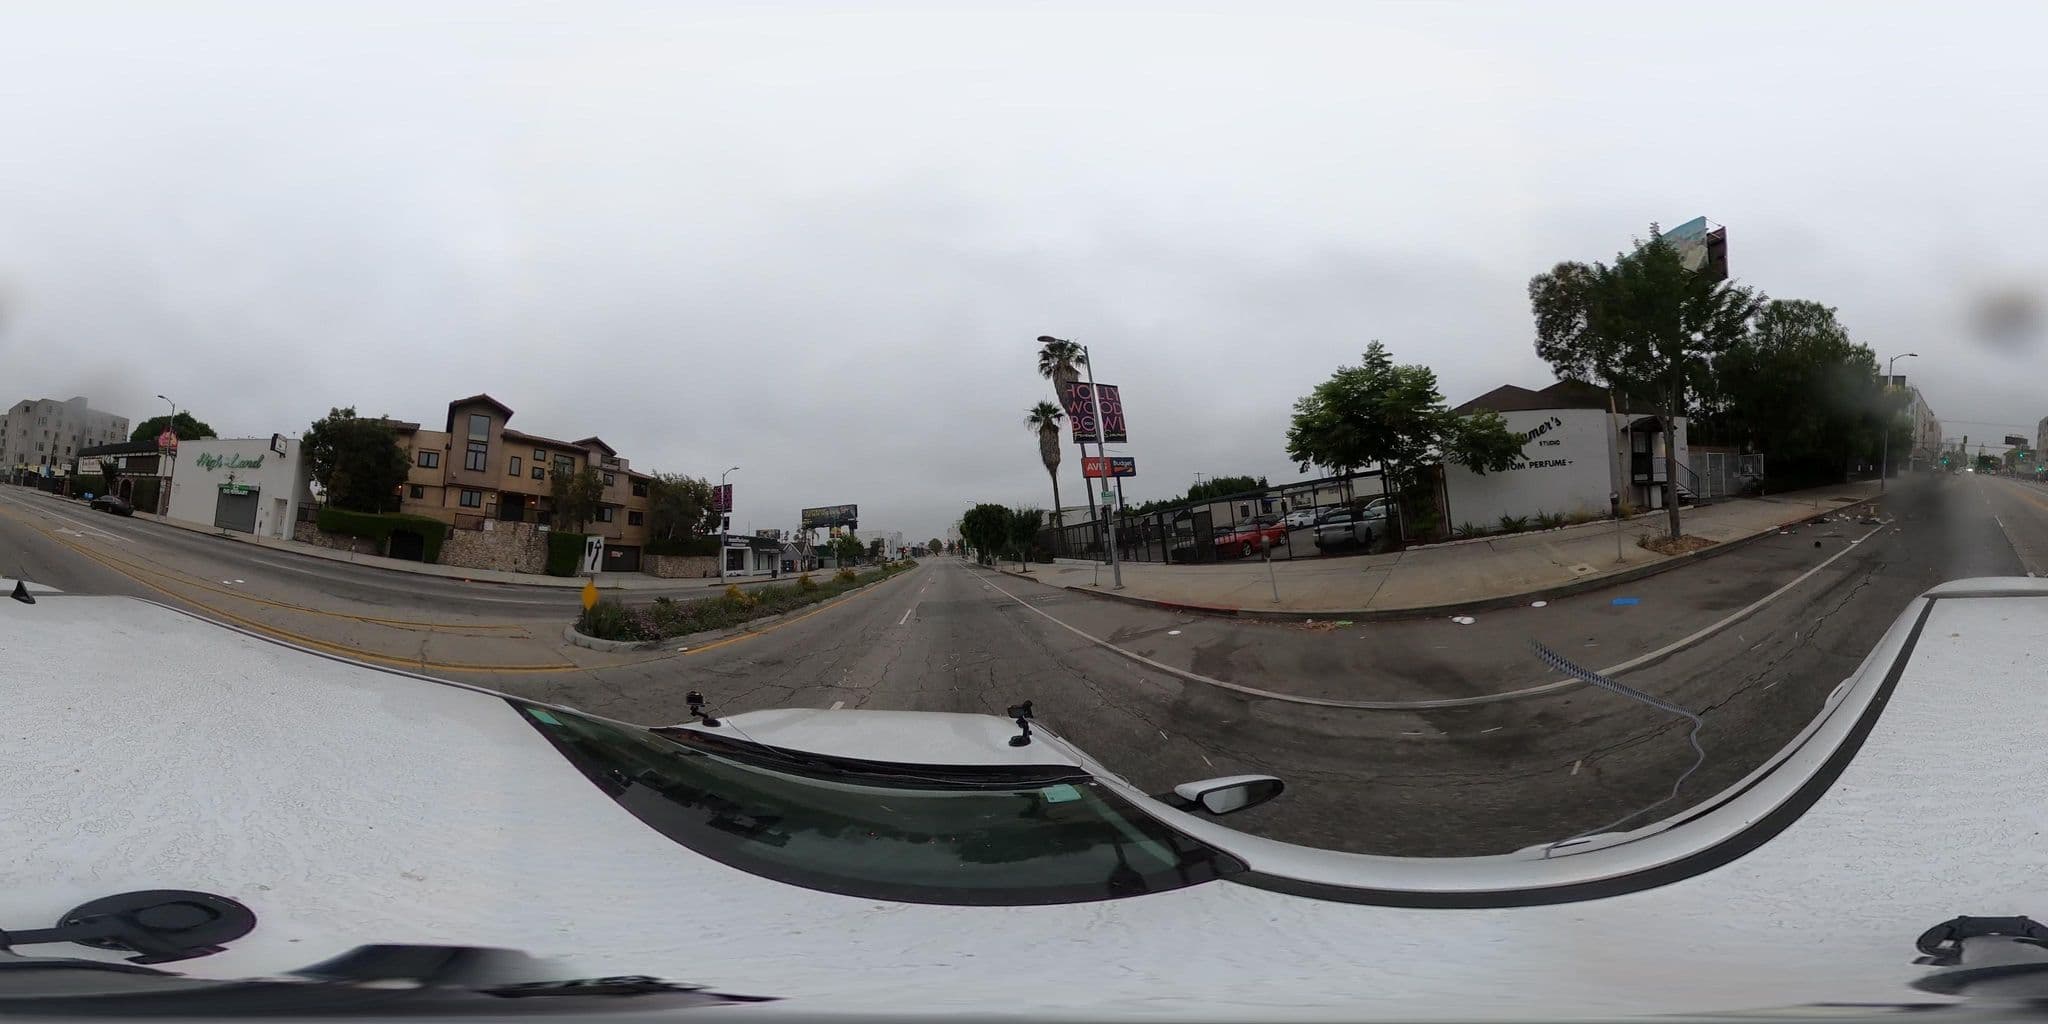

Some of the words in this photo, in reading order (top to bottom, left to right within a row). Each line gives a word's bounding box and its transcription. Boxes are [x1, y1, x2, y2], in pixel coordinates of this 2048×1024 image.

[1071, 415, 1126, 431] BOWL
[1113, 460, 1133, 469] Budget
[1529, 459, 1567, 469] PERFUME
